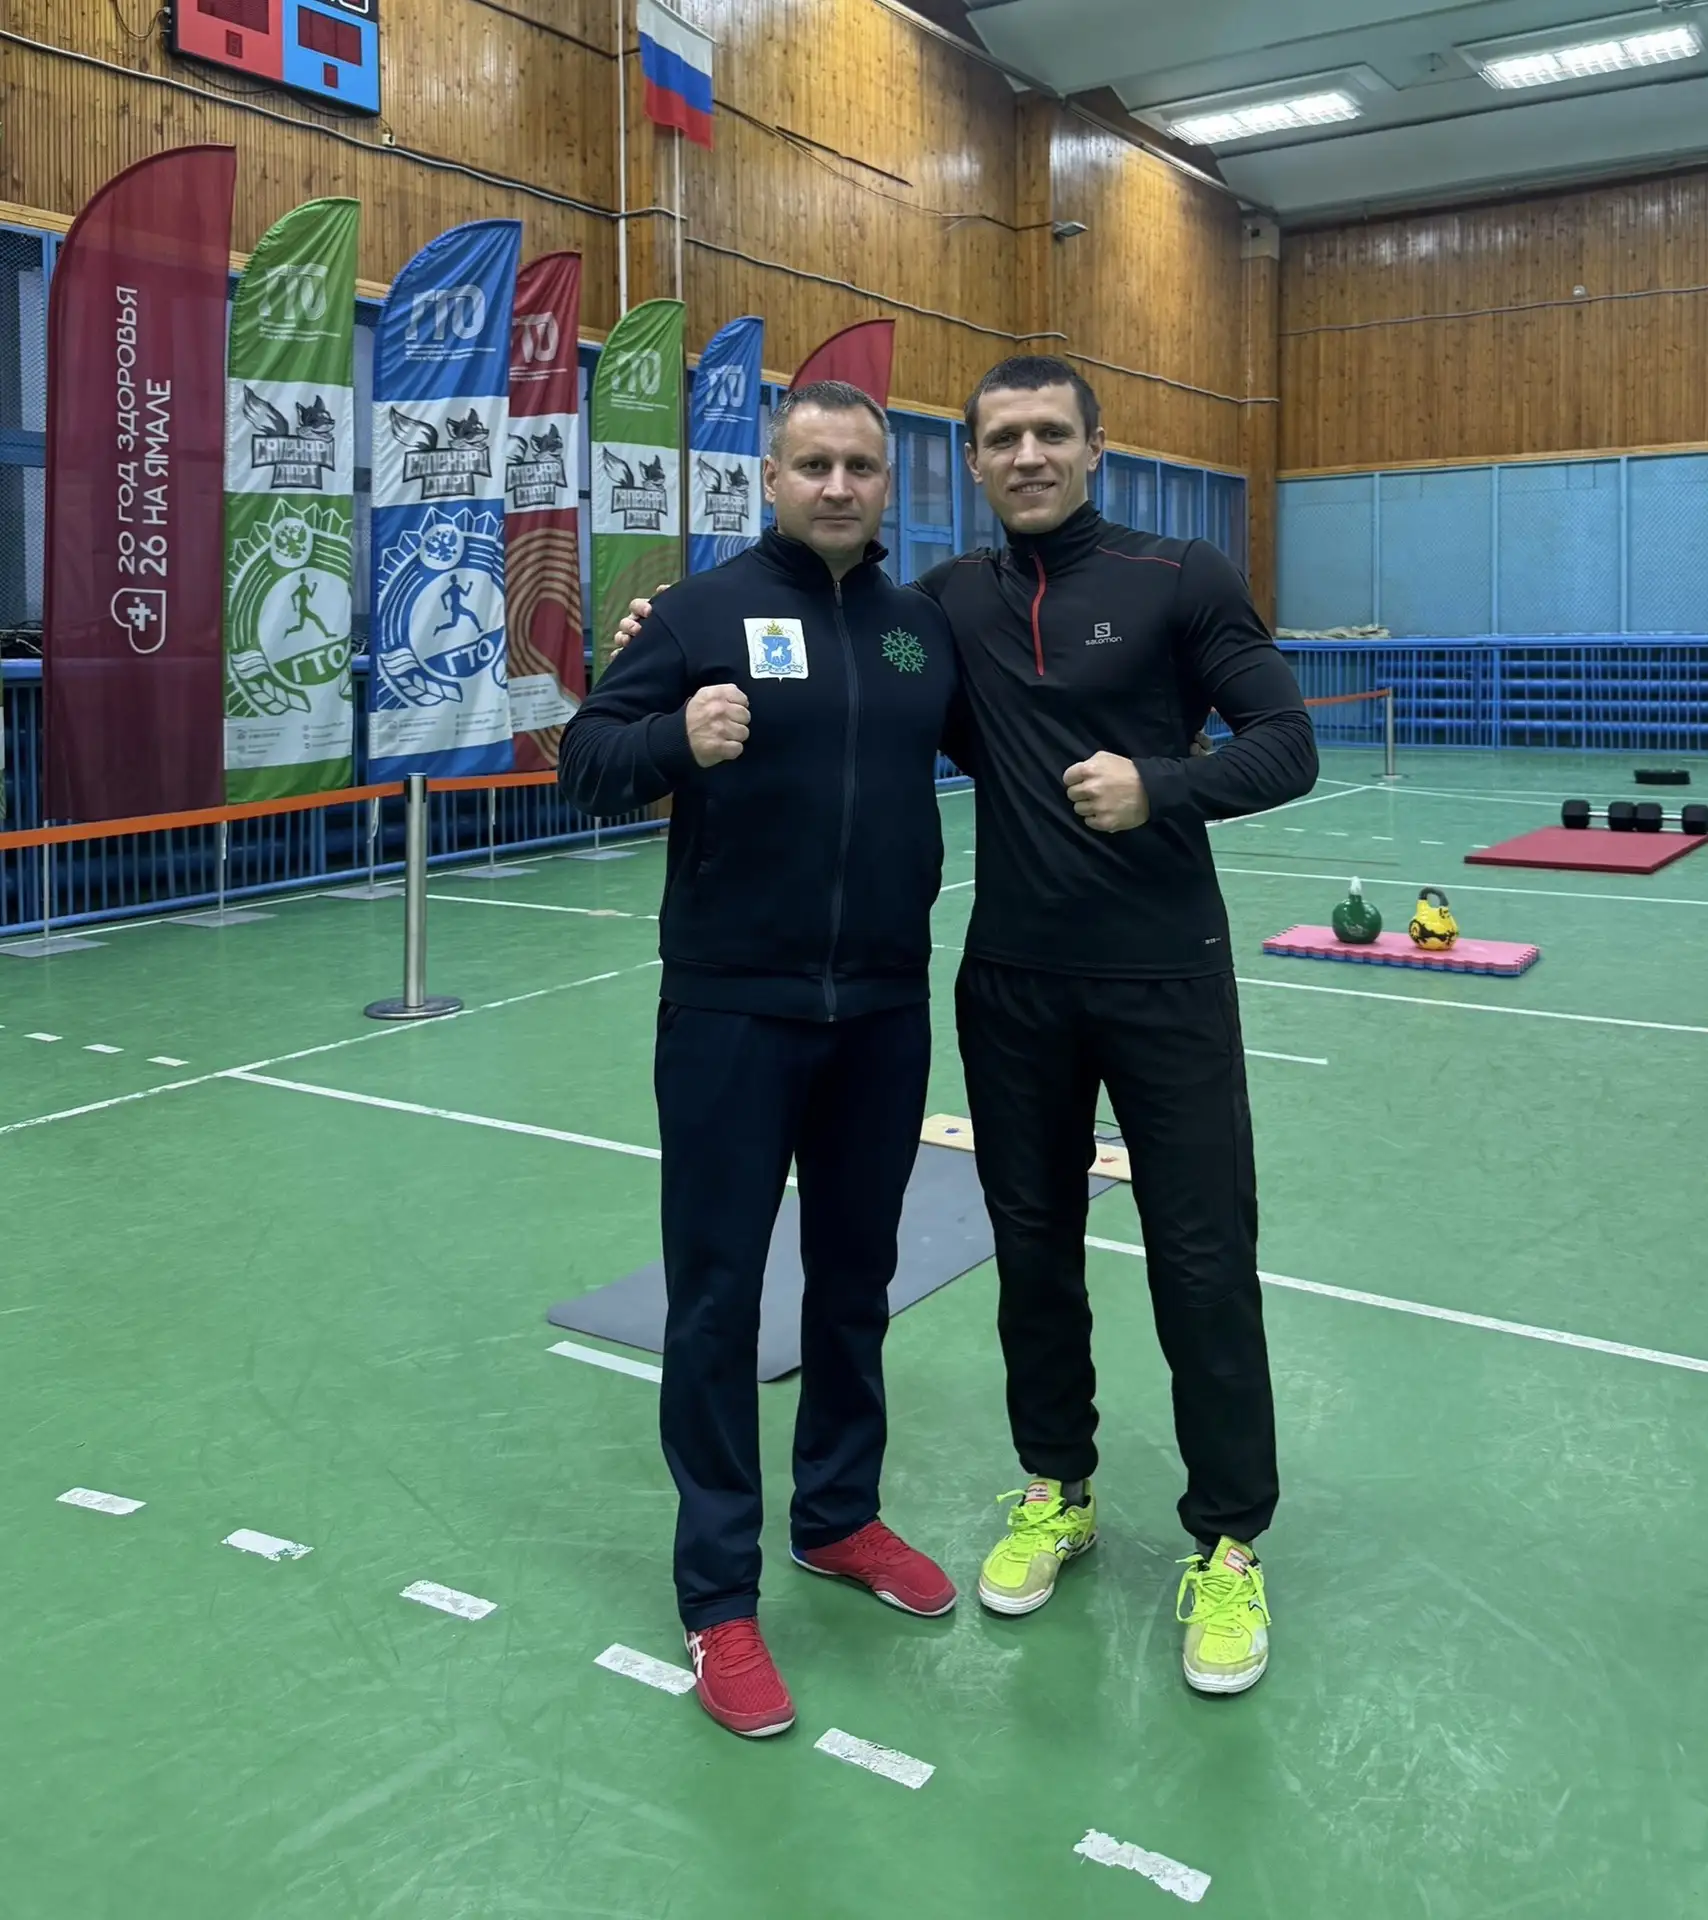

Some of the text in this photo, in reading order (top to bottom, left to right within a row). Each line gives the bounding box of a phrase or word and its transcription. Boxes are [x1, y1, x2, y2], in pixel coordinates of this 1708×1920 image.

[258, 263, 328, 321] ГТО
[404, 284, 485, 340] ГТО
[116, 285, 140, 576] 20 ГОД ЗДОРОВЬЯ
[139, 379, 171, 576] 26 НА ЯМАЛЕ
[291, 643, 345, 683] ГТО
[444, 638, 495, 676] ГТО
